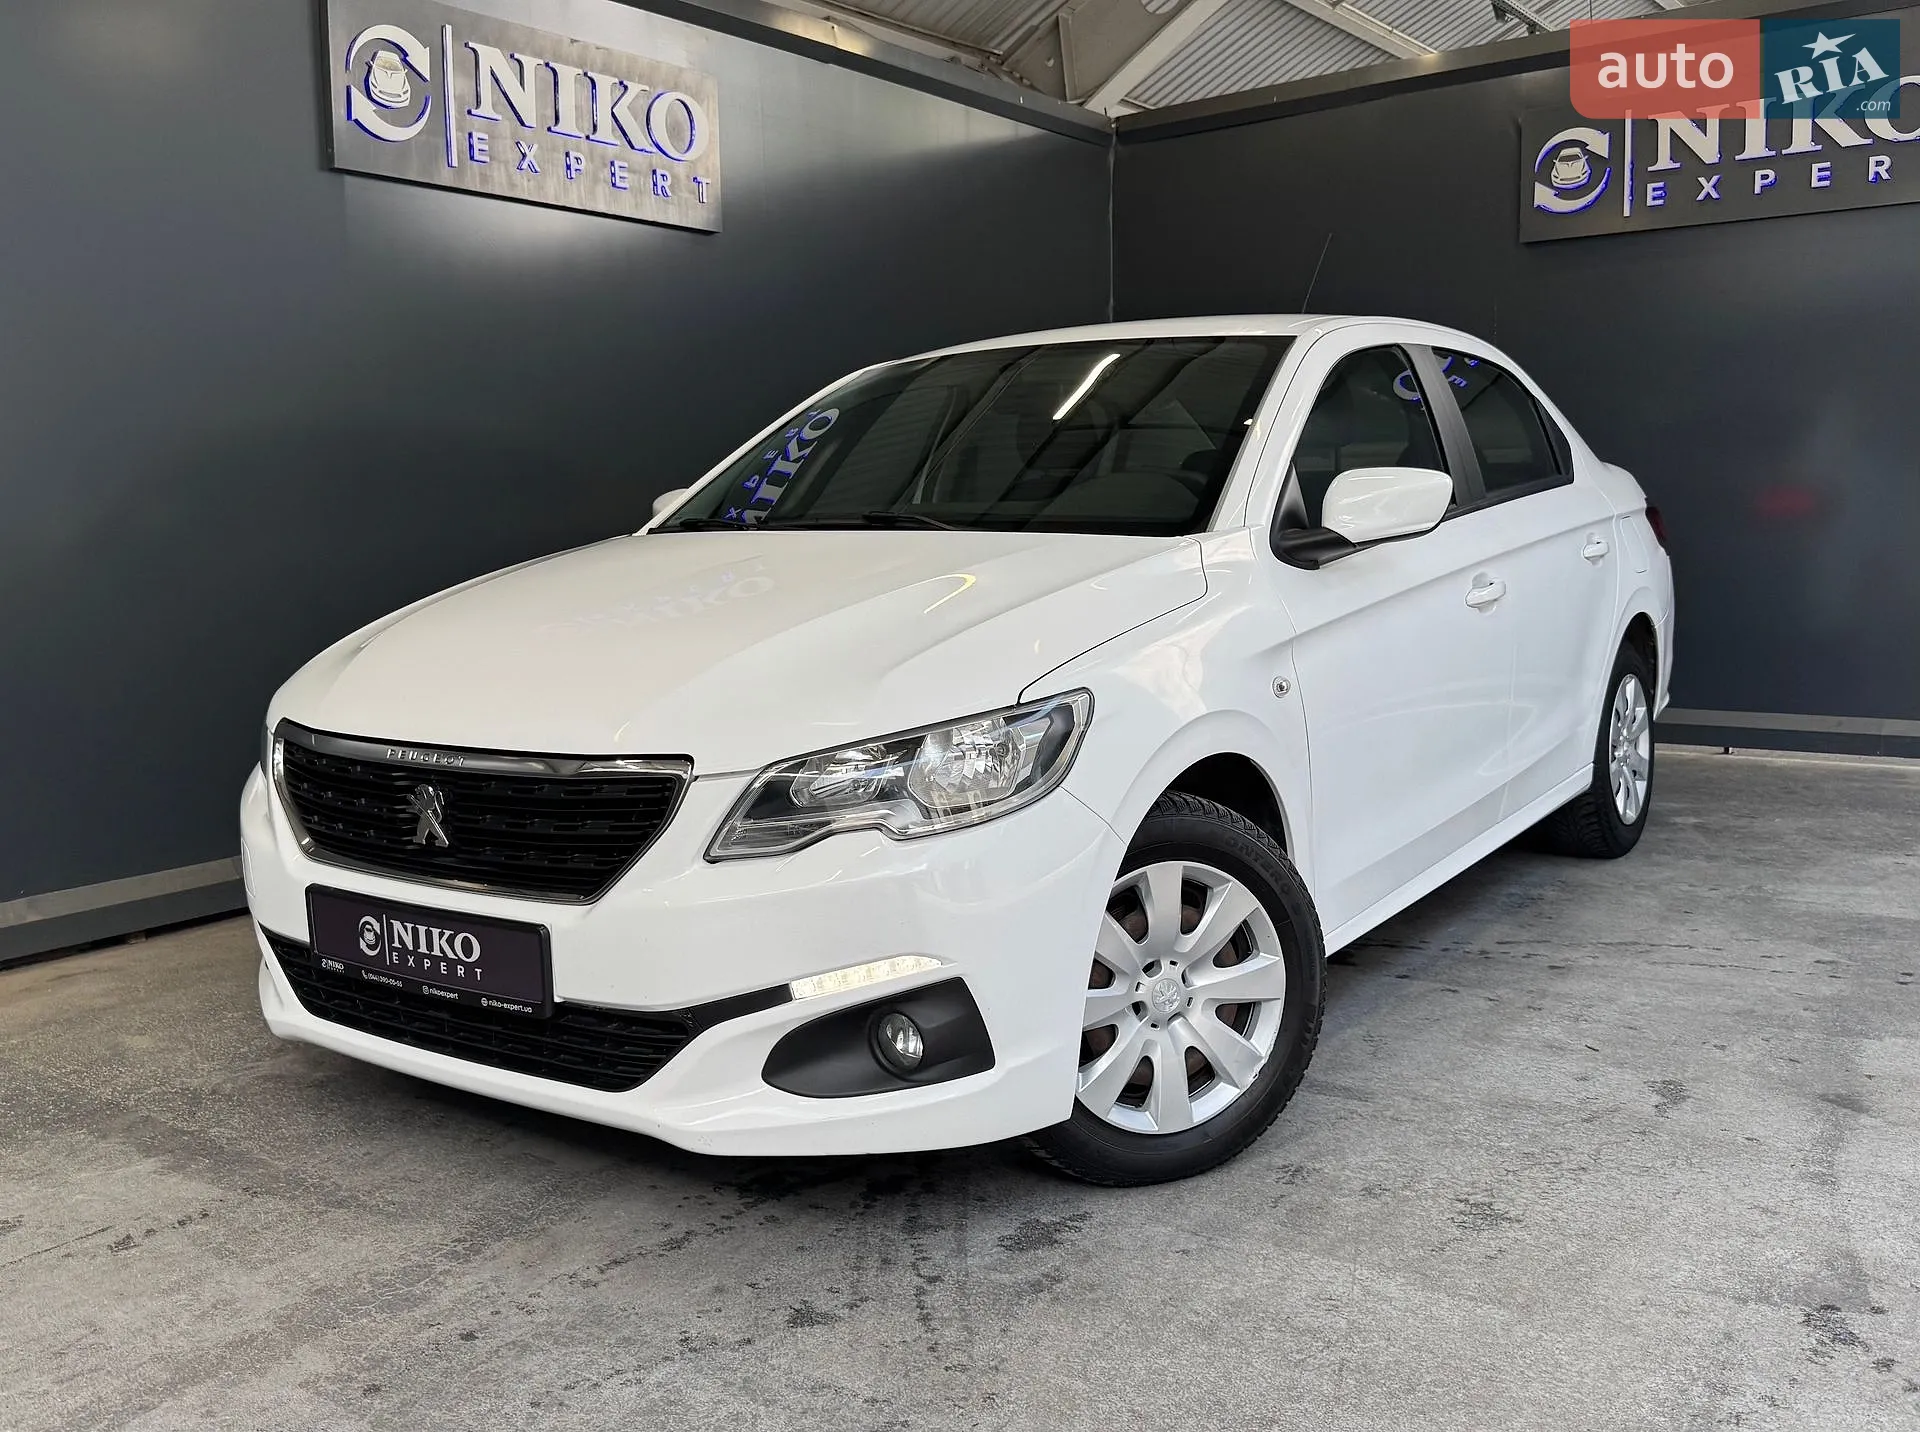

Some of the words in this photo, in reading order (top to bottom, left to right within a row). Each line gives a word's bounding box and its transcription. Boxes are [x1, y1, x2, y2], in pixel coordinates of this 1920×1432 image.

[464, 41, 710, 163] NIKO
[1647, 75, 1920, 172] NIKO
[467, 131, 711, 204] EXPERT
[1646, 155, 1893, 207] EXPER
[386, 748, 464, 767] PEUGEOT
[390, 919, 481, 963] NIKO
[393, 952, 483, 982] EXPERT
[429, 987, 459, 999] nikoexpert
